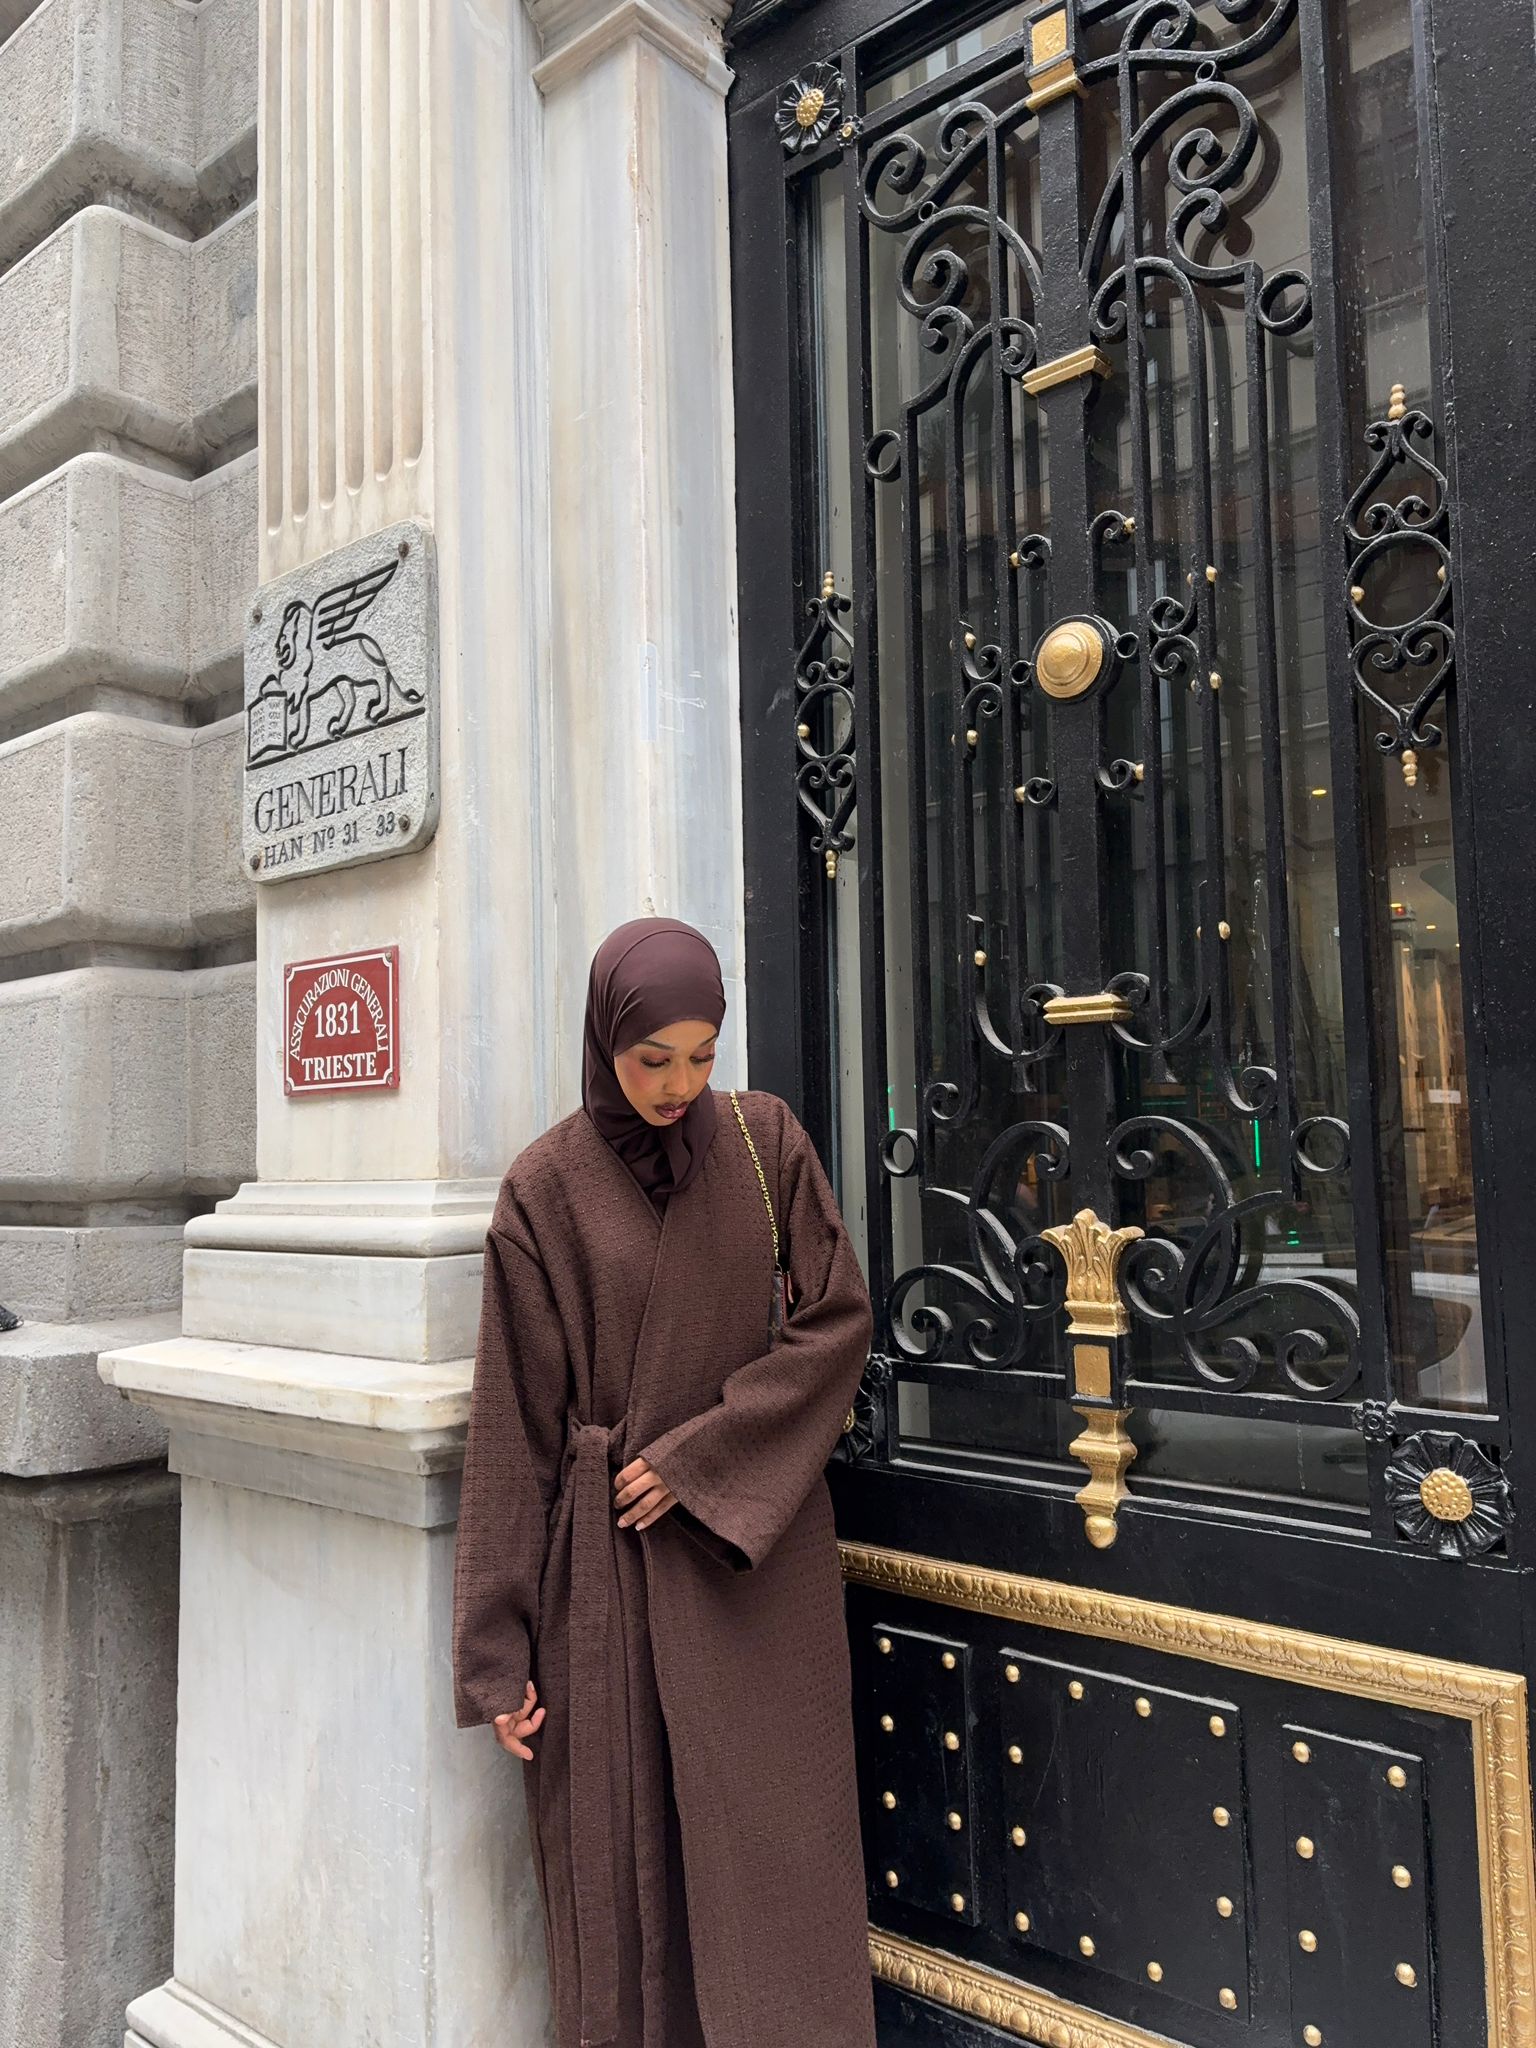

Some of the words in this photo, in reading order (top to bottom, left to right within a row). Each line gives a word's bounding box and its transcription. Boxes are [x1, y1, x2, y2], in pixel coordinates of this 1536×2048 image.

[254, 746, 409, 834] GENERALI
[263, 836, 304, 869] HAN
[342, 820, 360, 846] 31
[375, 811, 396, 837] 33
[290, 968, 351, 1061] ASSICURAZIONI
[350, 973, 389, 1053] GENERALI
[314, 1000, 361, 1039] 1831
[301, 1051, 377, 1082] TRIESTE
